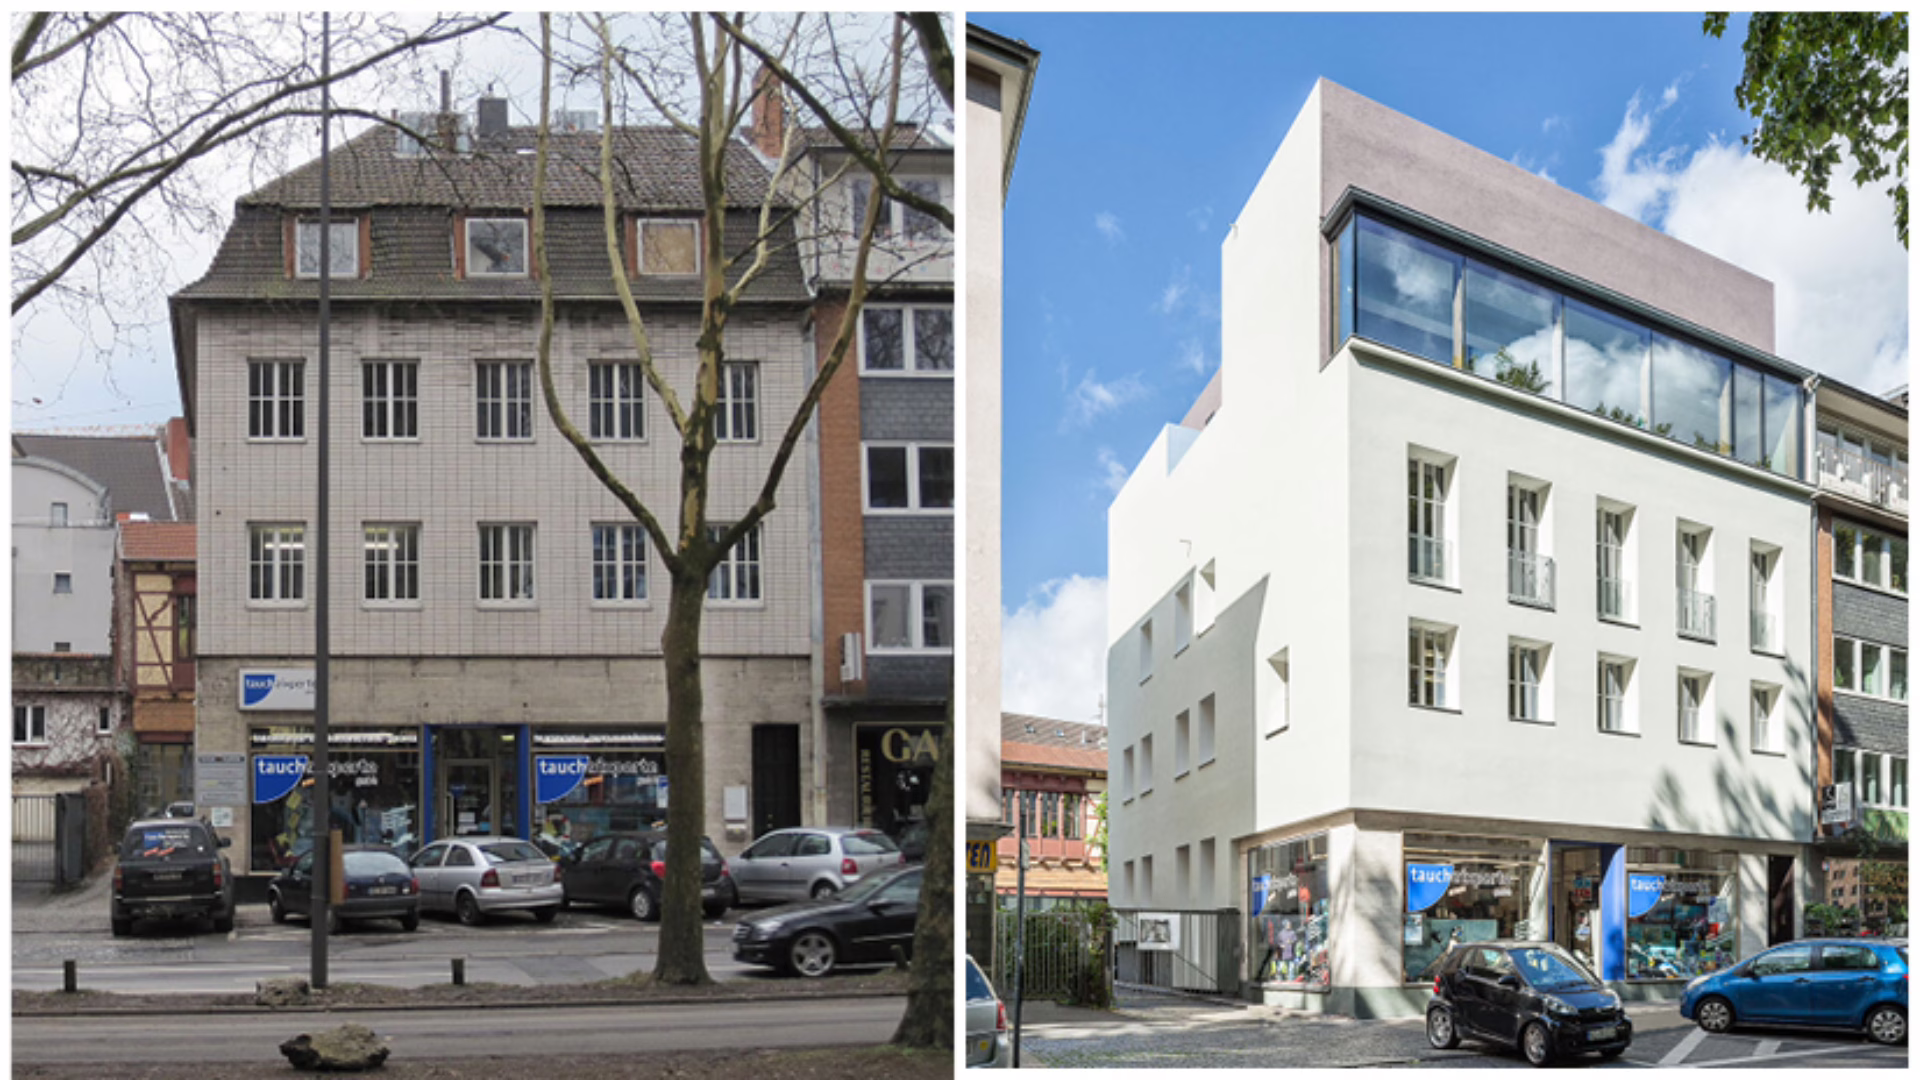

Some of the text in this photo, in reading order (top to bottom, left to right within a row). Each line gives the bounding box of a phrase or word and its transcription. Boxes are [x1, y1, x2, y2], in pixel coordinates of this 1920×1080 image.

[881, 727, 939, 763] GA
[258, 758, 305, 775] tauch
[540, 758, 587, 775] tauch
[1411, 867, 1453, 883] tauch
